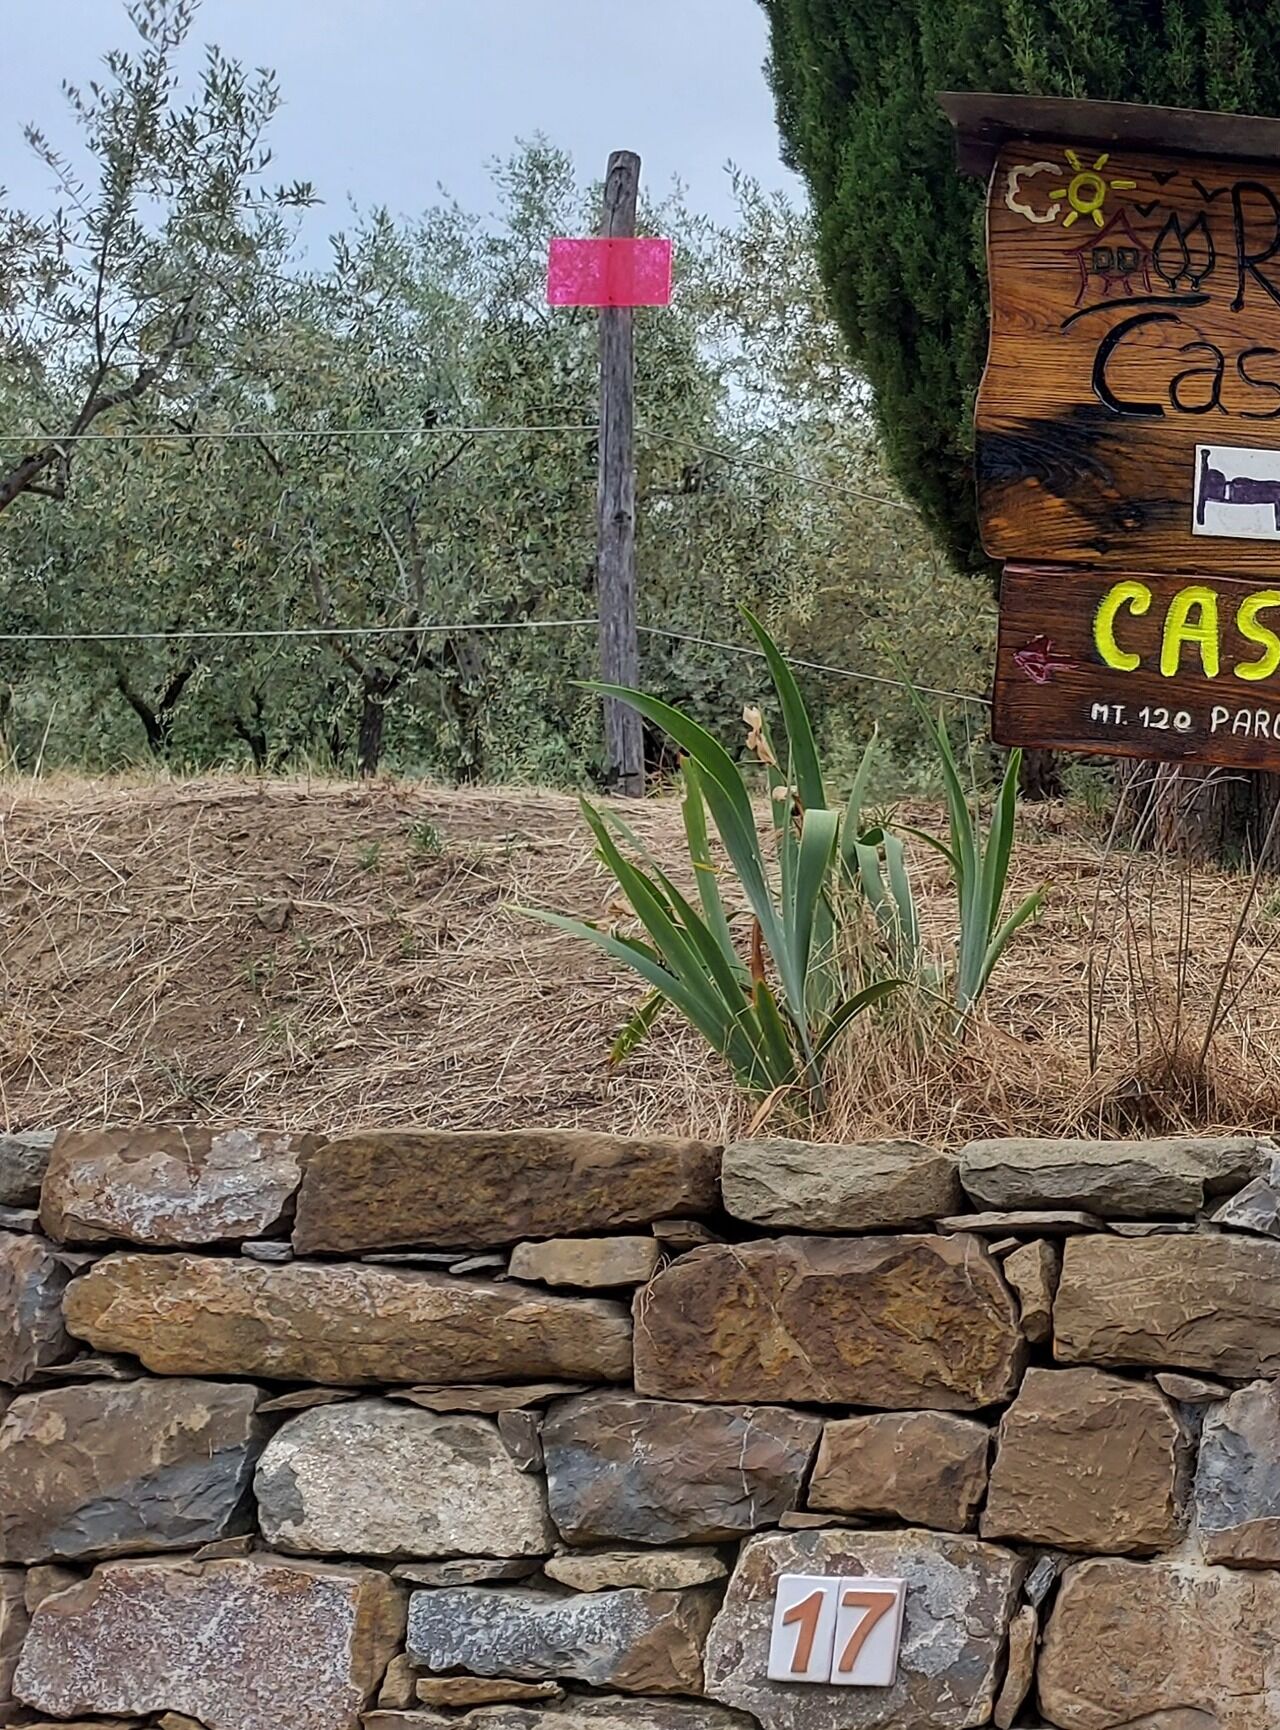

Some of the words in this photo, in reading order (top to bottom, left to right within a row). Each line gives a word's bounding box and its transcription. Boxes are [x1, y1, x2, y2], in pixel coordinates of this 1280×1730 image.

[1090, 702, 1128, 726] MT.
[1138, 706, 1192, 731] 120
[782, 1590, 898, 1673] 17
